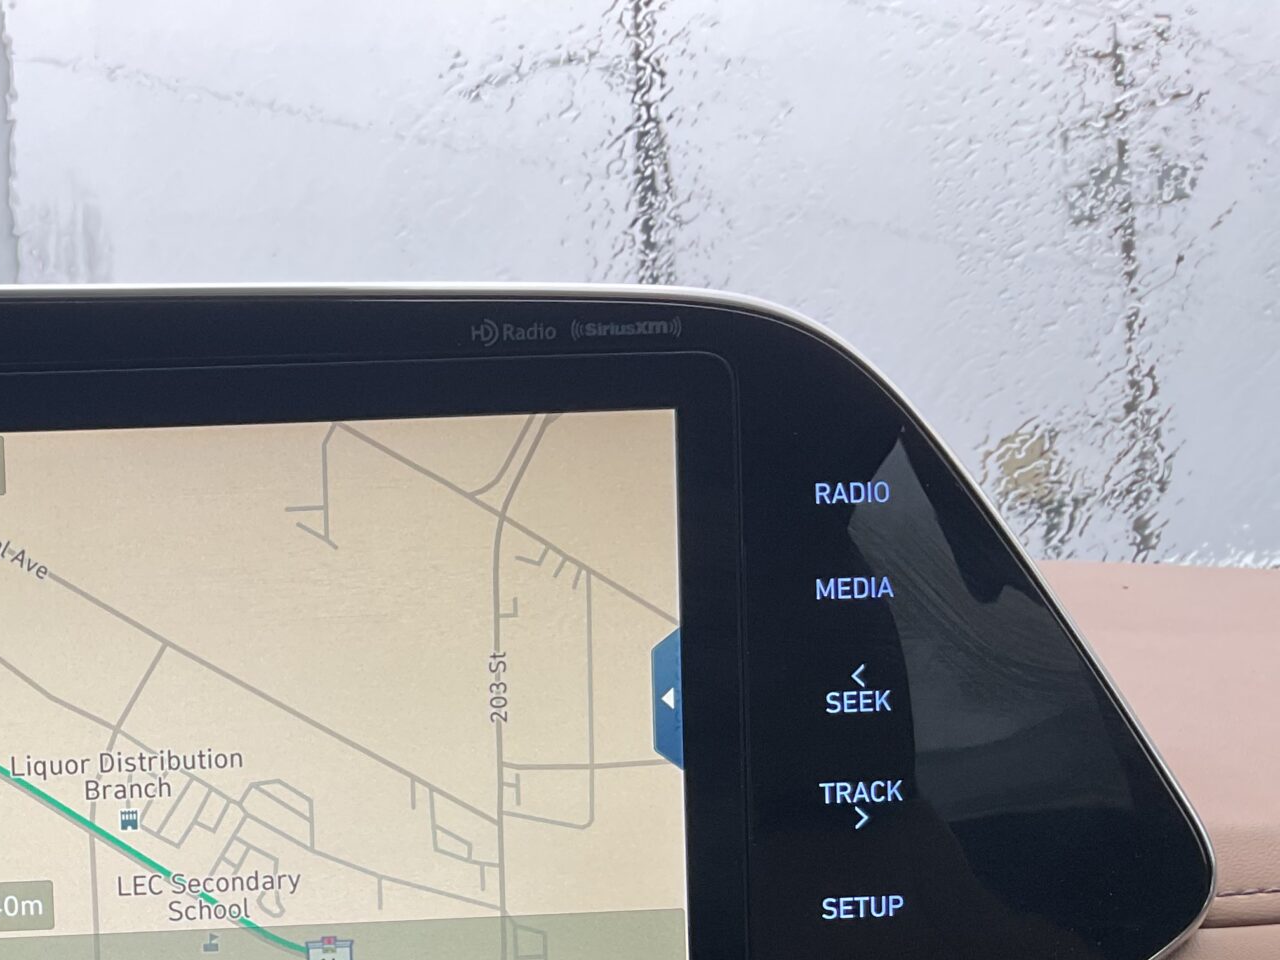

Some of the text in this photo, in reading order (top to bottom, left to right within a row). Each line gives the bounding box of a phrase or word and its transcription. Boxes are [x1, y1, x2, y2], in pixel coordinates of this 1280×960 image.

[503, 322, 557, 341] Radio
[815, 481, 890, 505] RADIO
[11, 550, 48, 580] Ave
[815, 576, 894, 600] MEDIA
[489, 652, 508, 723] 203 St
[825, 690, 891, 713] SEEK
[10, 748, 243, 780] Liquor Distribution
[85, 777, 172, 801] Branch
[819, 779, 903, 804] TRACK
[118, 870, 301, 897] LEC Secondary
[169, 898, 251, 922] School
[822, 895, 904, 919] SETUP
